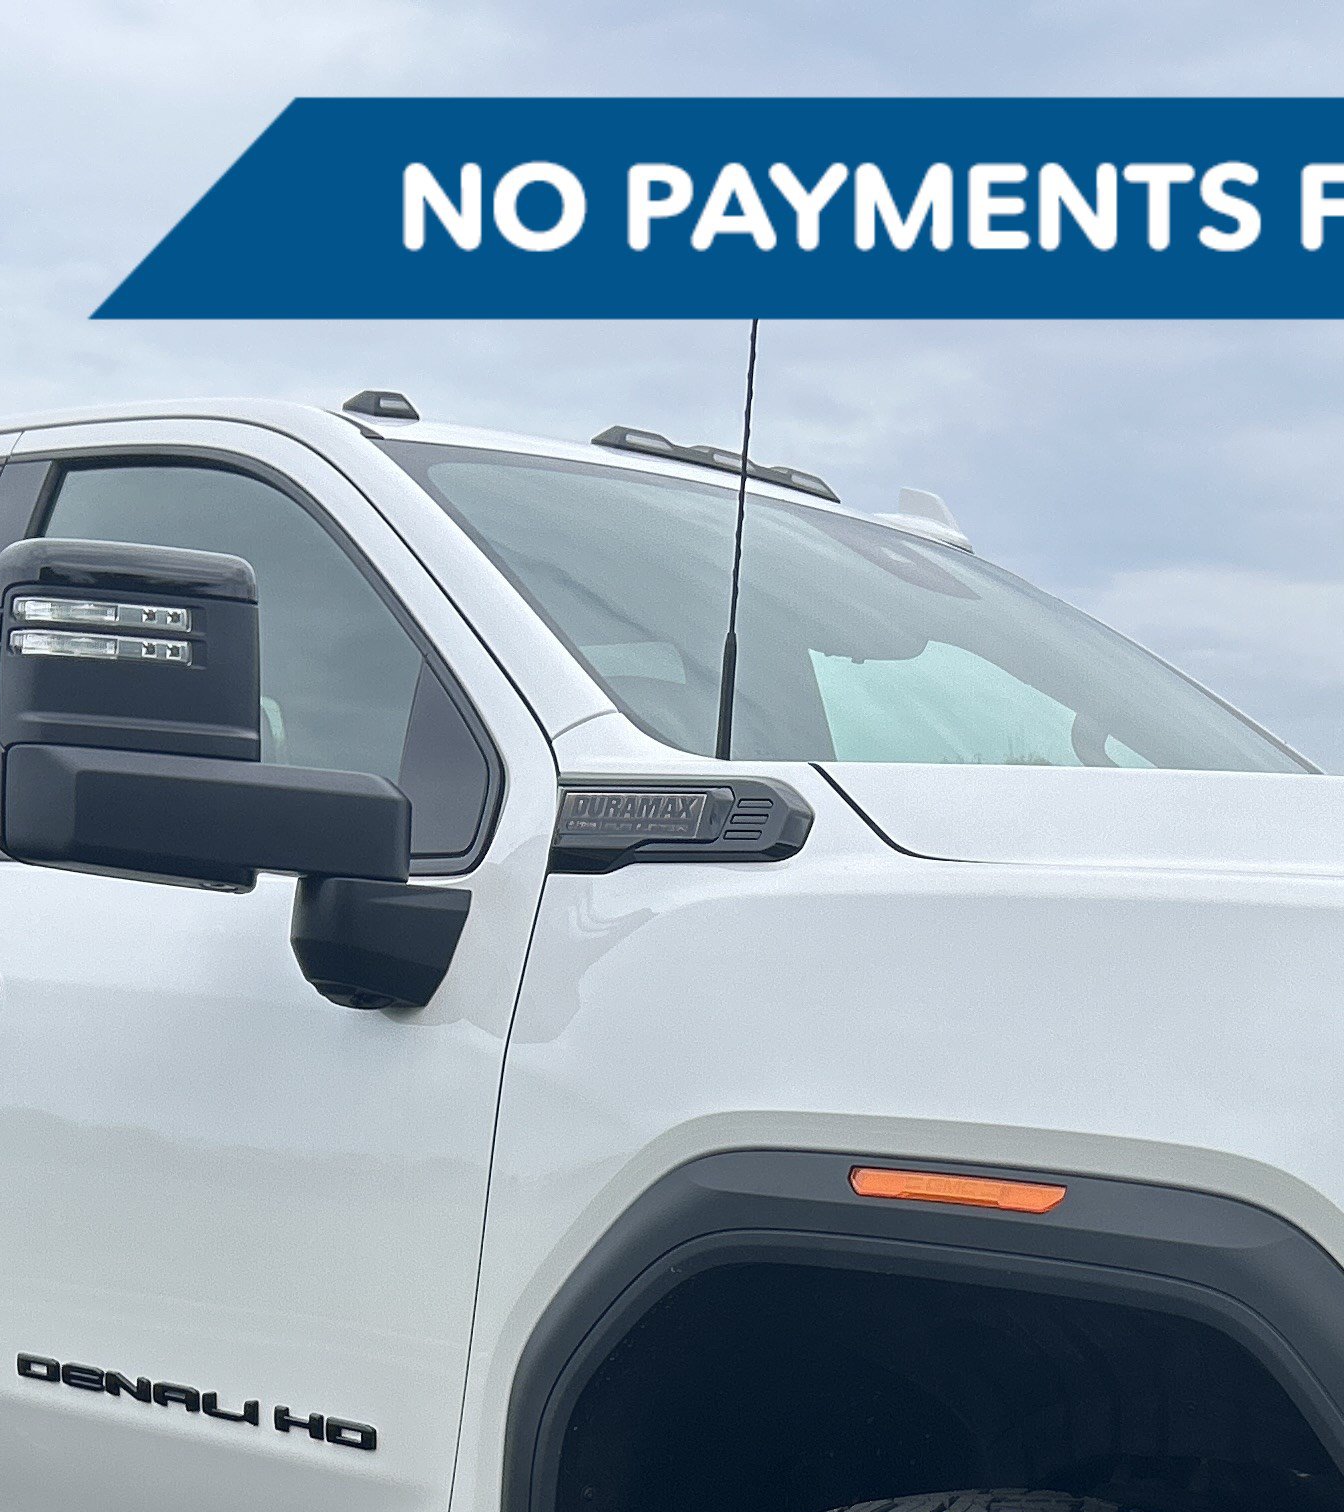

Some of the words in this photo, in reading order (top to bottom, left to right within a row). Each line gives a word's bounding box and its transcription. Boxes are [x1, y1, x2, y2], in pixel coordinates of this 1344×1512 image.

[574, 796, 698, 819] DURAMAX
[17, 1353, 259, 1427] DENALI
[274, 1405, 378, 1452] HD
